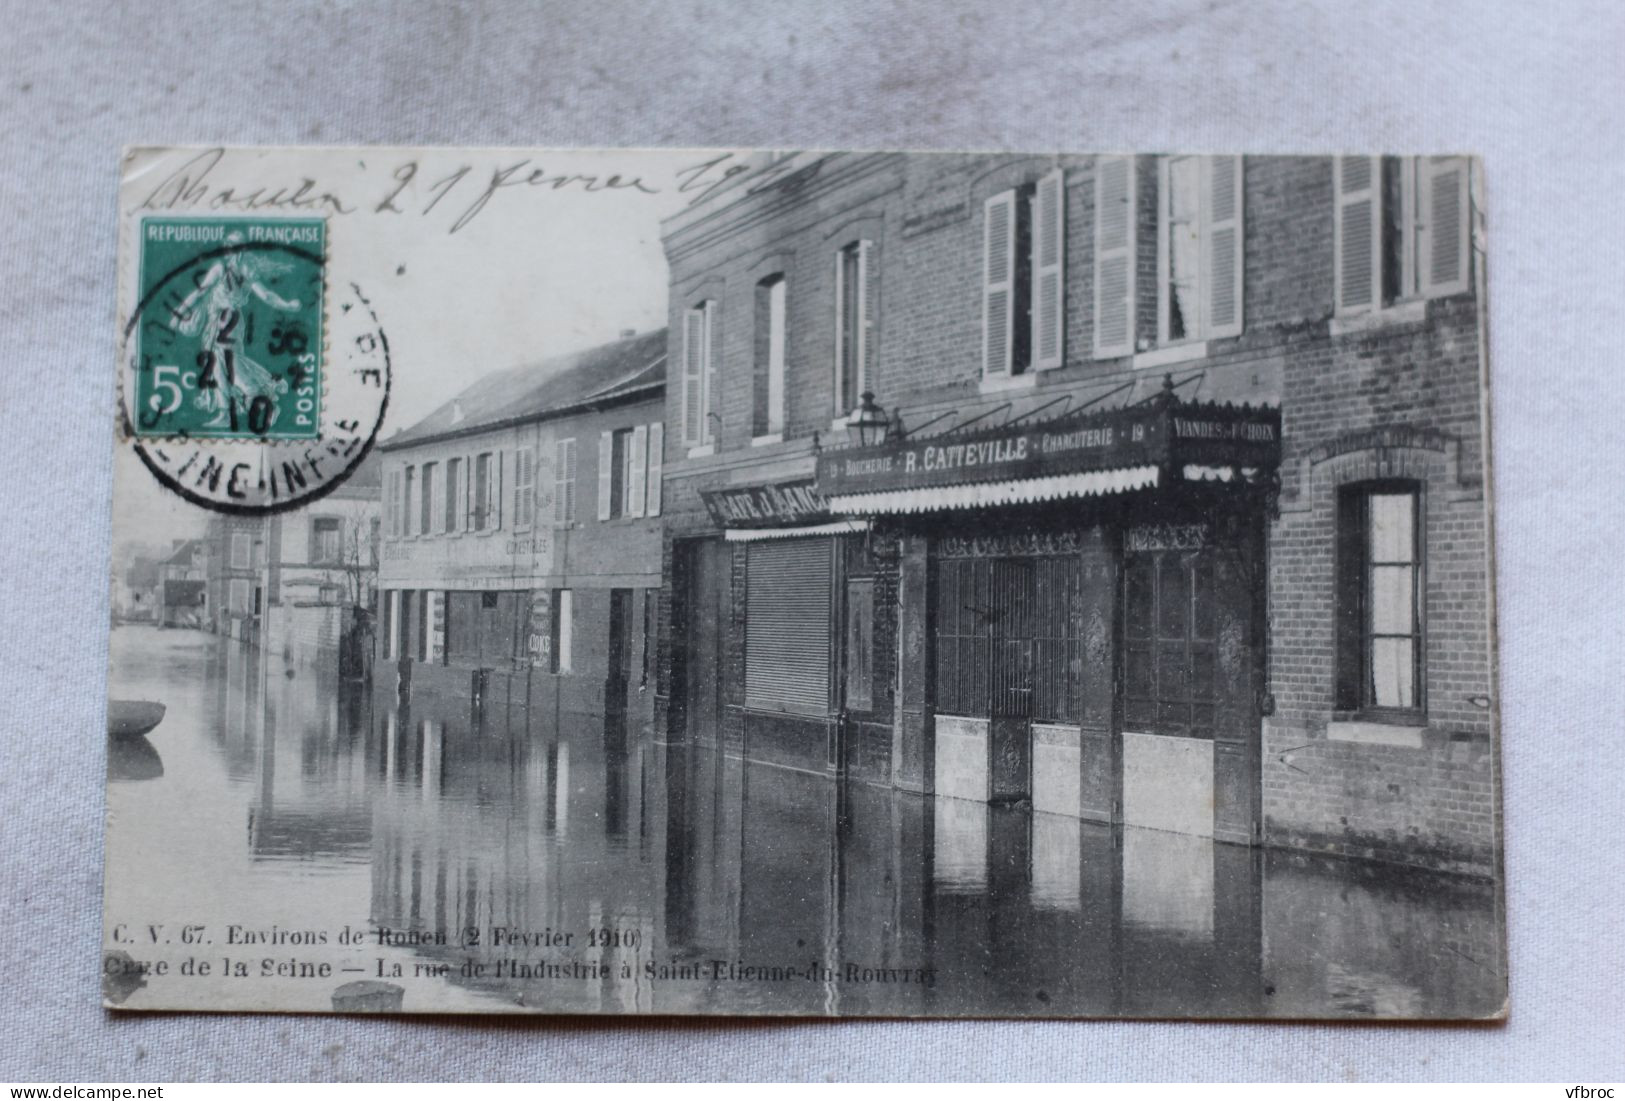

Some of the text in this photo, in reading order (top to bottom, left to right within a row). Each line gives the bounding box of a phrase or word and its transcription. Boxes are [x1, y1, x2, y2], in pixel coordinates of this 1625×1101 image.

[249, 226, 319, 244] FRANÇAISE
[229, 394, 274, 434] 10
[845, 456, 893, 477] BOUCHERIE
[924, 437, 1027, 471] CATTEVILLE
[1042, 427, 1113, 453] CHARCUTERIE
[112, 923, 136, 945] C.
[148, 923, 171, 945] V.
[181, 923, 213, 945] 67.
[226, 924, 328, 946] Environs
[338, 925, 363, 946] de
[378, 926, 446, 946] Rouen
[493, 926, 574, 947] Février
[181, 956, 212, 977] de
[222, 957, 249, 978] la
[260, 957, 333, 978] Seine
[376, 958, 403, 978] La
[414, 961, 450, 978] rue
[460, 958, 485, 978] de
[495, 958, 610, 980] l'Industrie
[620, 960, 632, 980] à
